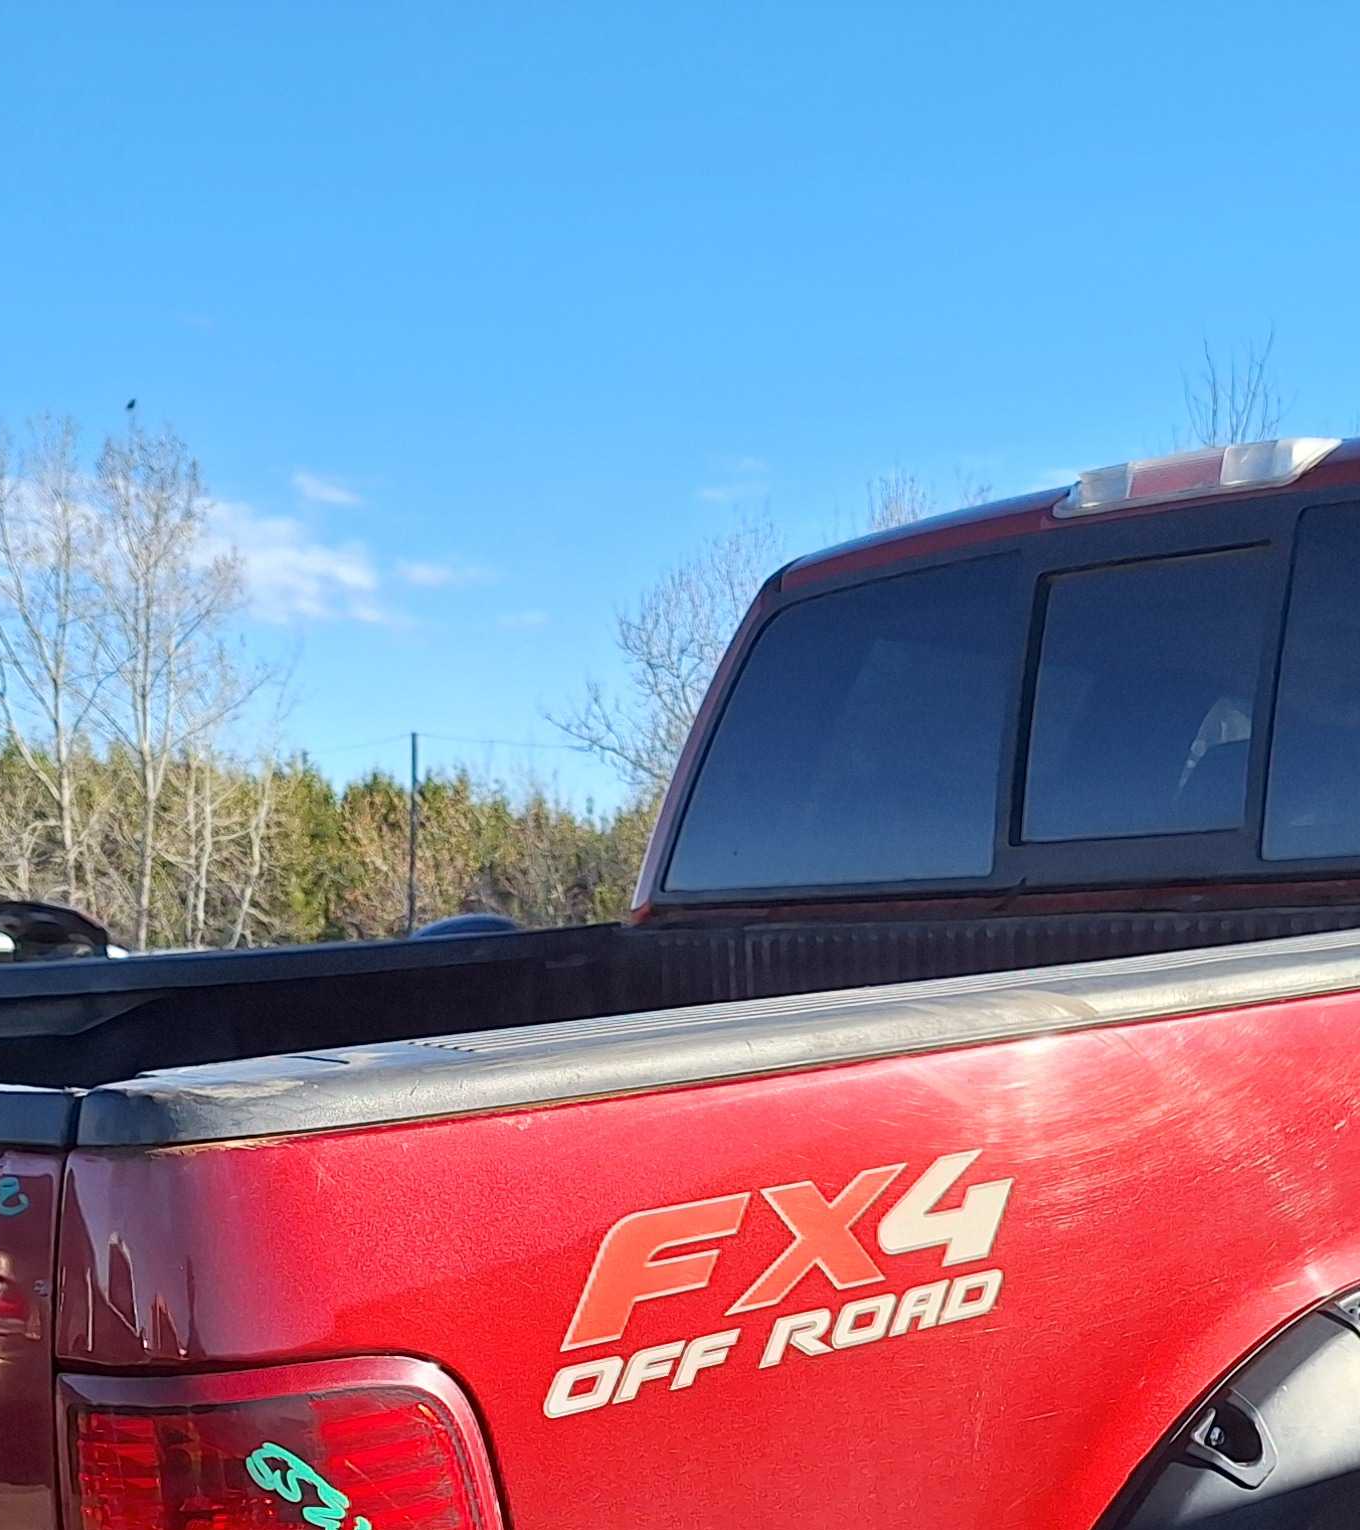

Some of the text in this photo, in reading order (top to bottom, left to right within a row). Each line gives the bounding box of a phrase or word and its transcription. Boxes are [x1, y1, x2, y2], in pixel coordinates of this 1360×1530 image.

[560, 1148, 1014, 1353] FX4
[543, 1268, 1004, 1420] OFF ROAD
